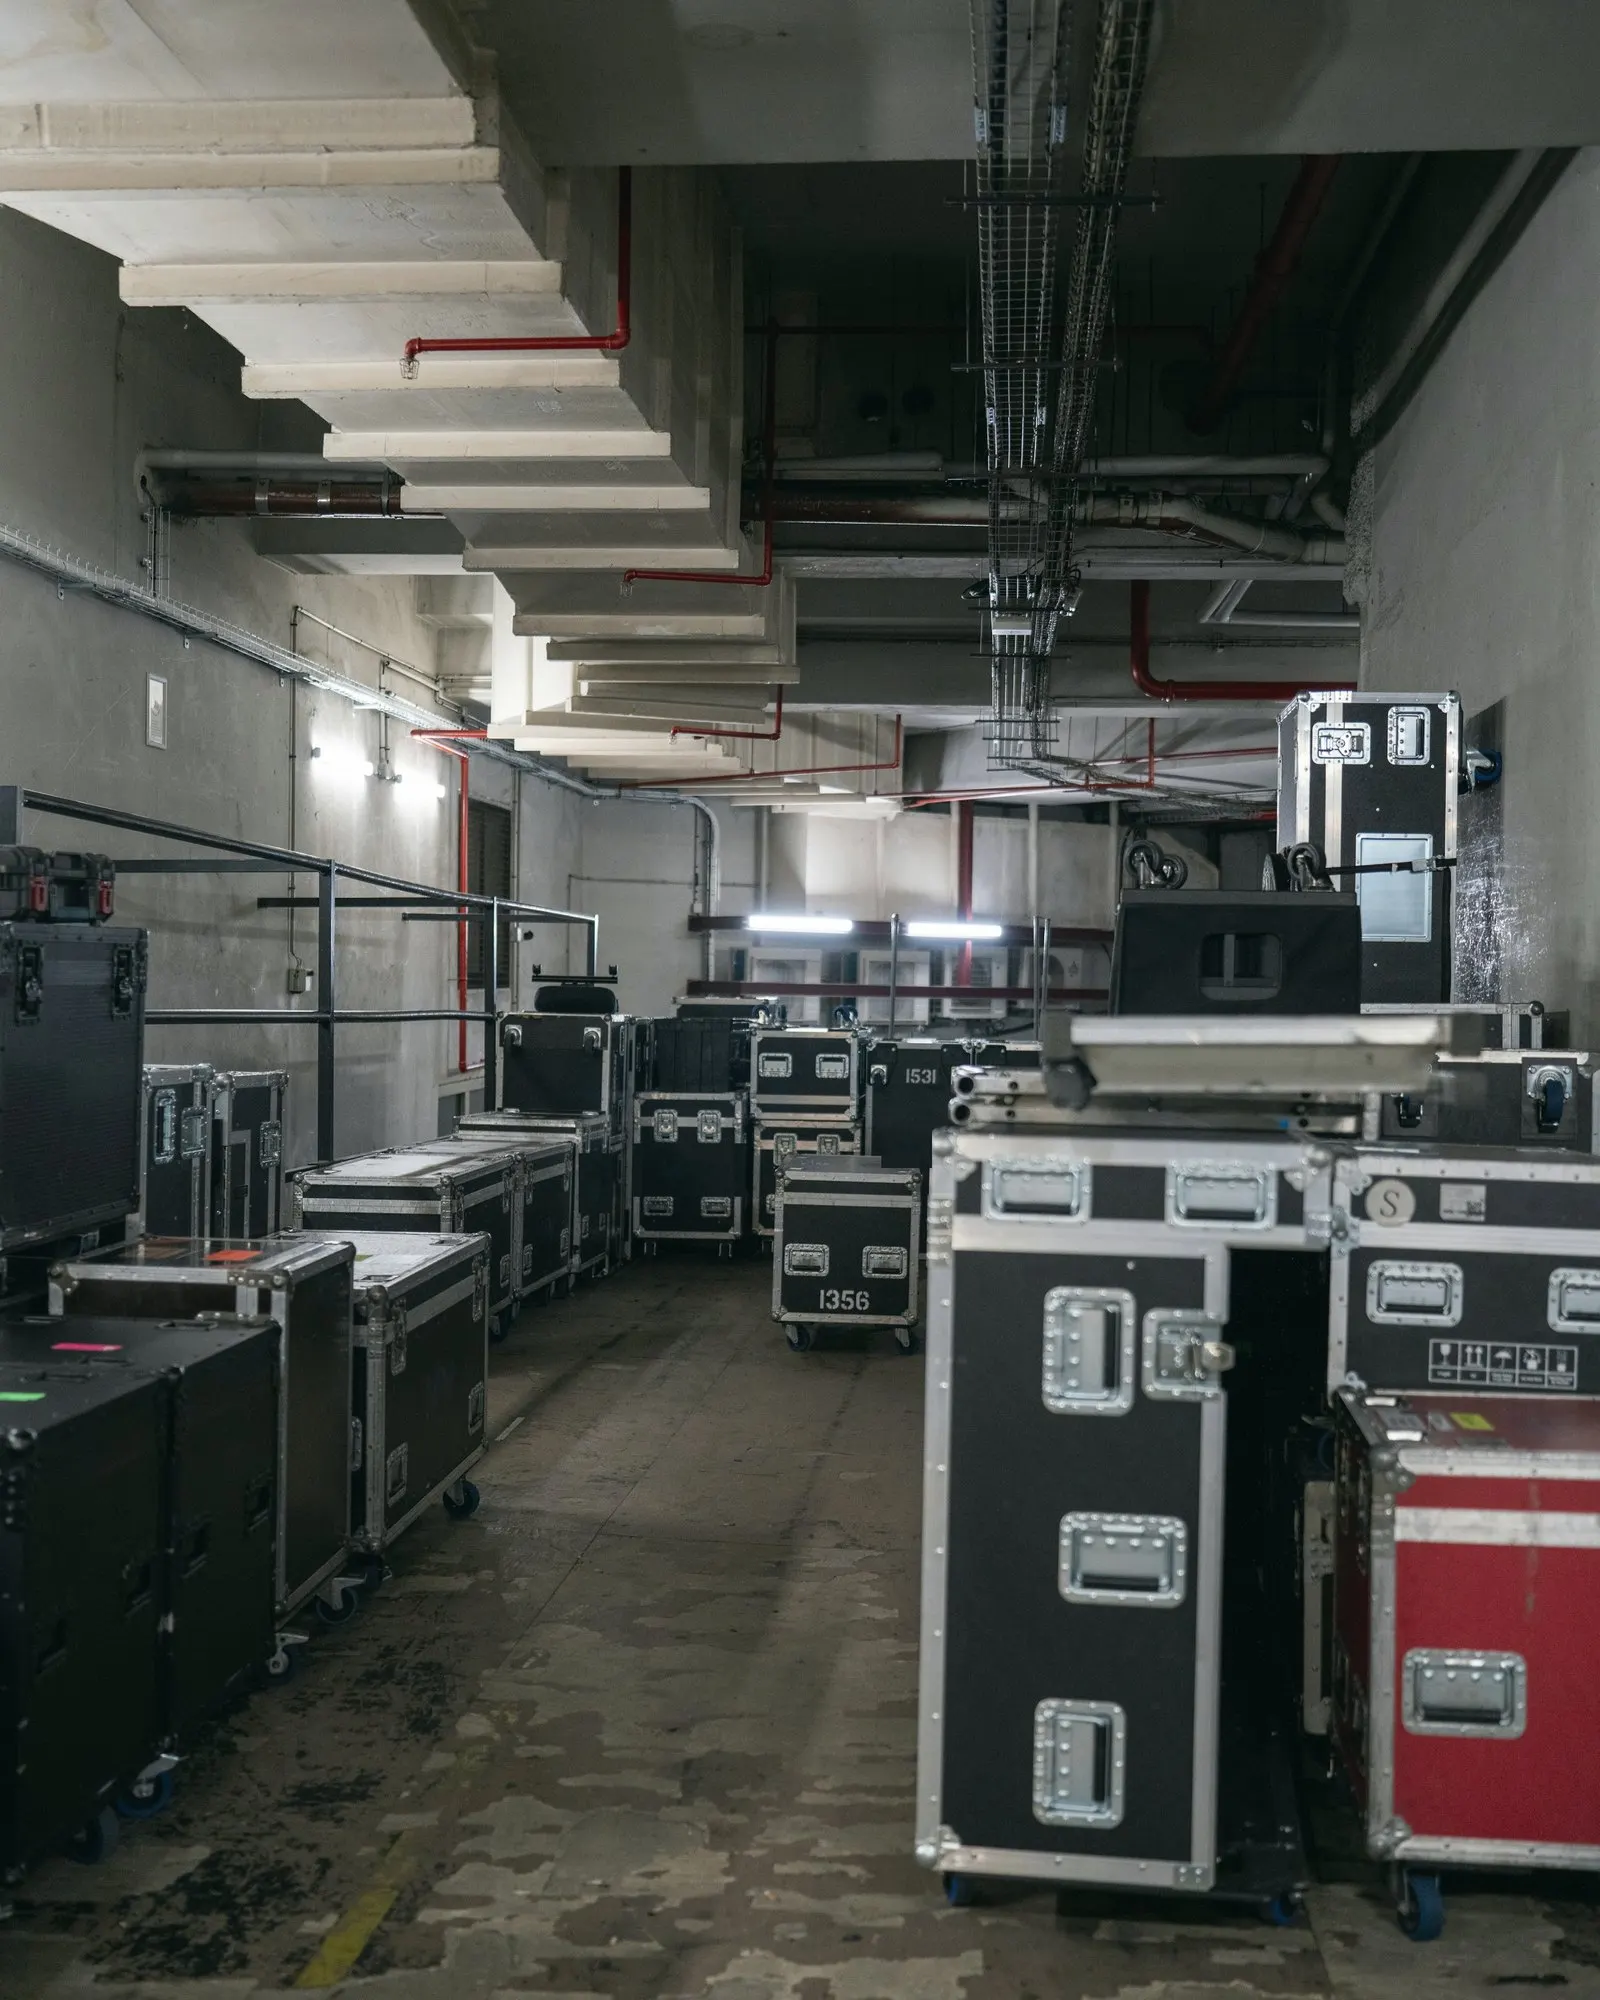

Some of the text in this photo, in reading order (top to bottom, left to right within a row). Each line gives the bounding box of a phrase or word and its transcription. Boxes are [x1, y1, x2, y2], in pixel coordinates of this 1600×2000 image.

[905, 1068, 936, 1084] 1531
[1380, 1190, 1400, 1218] S
[819, 1289, 870, 1311] 1356
